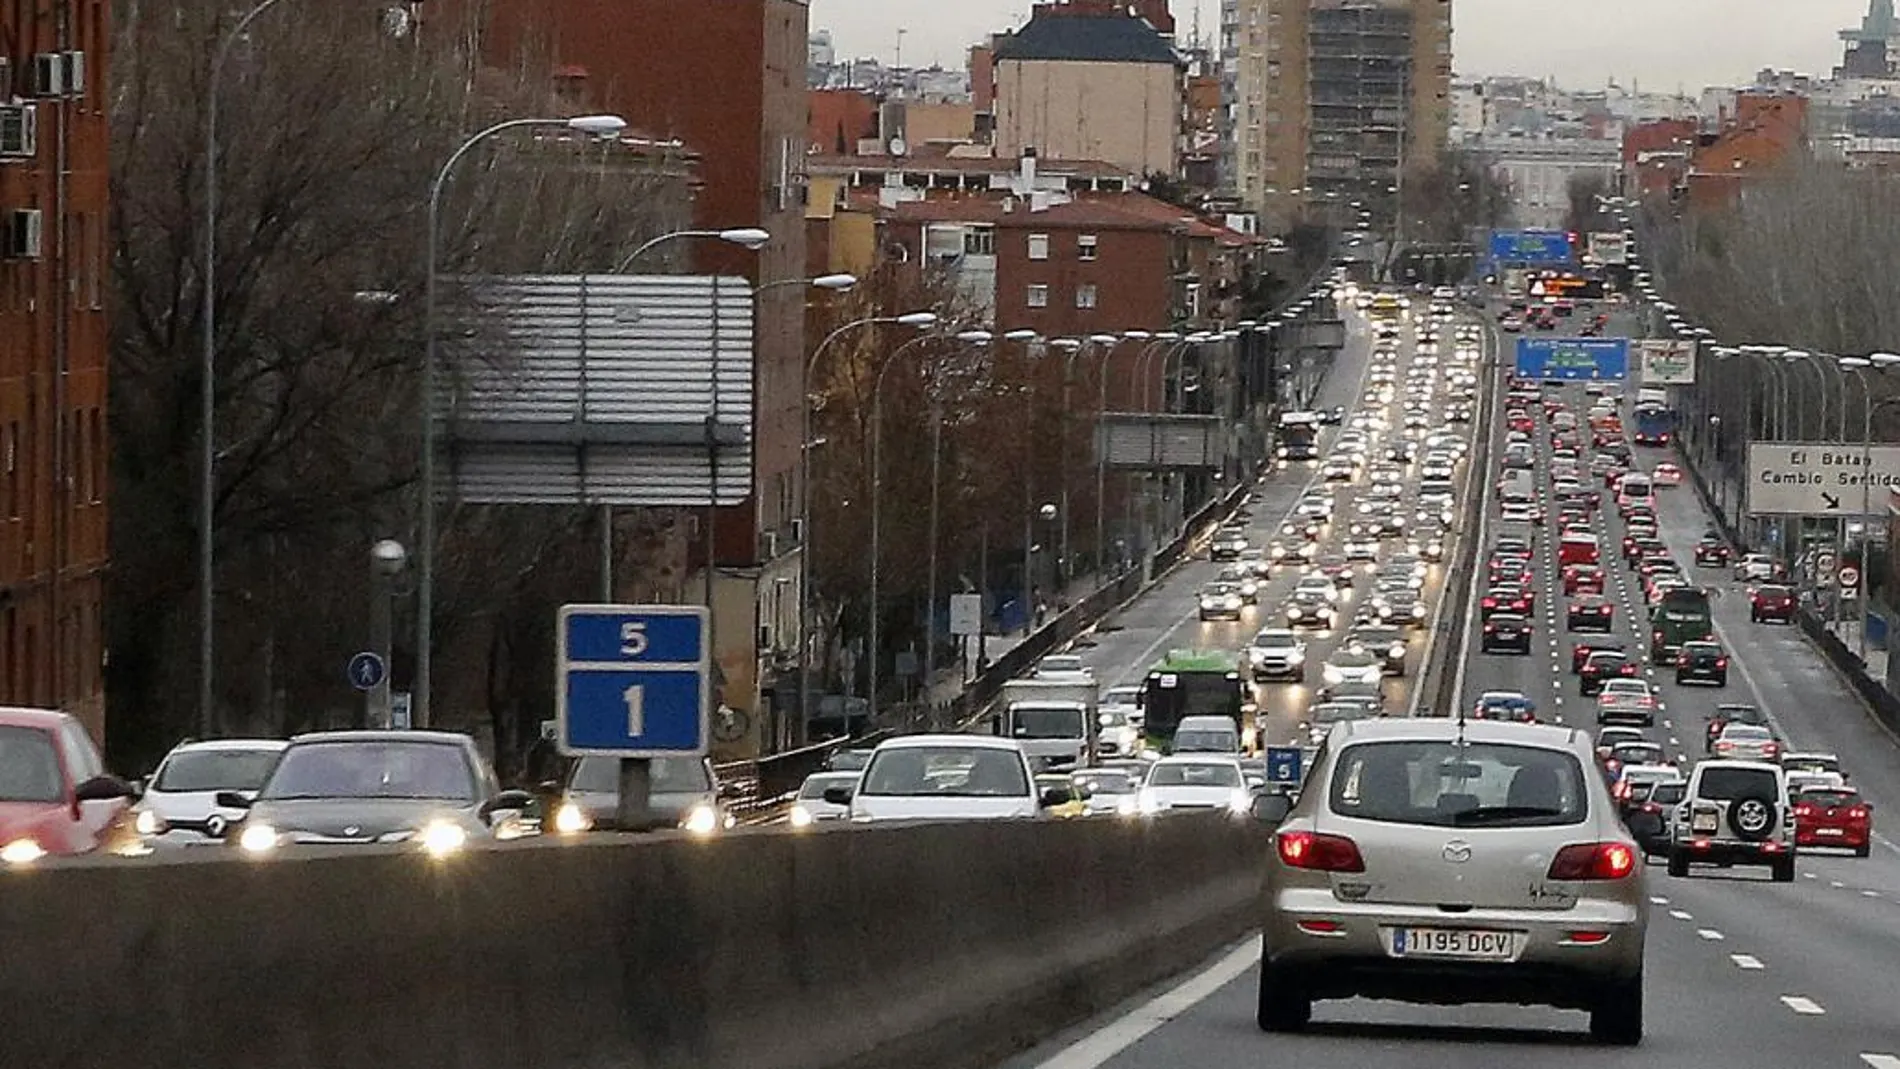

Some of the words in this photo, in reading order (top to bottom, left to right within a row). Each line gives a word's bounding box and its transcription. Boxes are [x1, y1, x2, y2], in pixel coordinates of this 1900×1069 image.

[1790, 451, 1806, 464] El
[1761, 470, 1822, 484] Cambio
[620, 622, 648, 654] 5
[622, 685, 645, 737] 1
[1411, 931, 1461, 952] 1195
[1467, 933, 1507, 953] DCV
